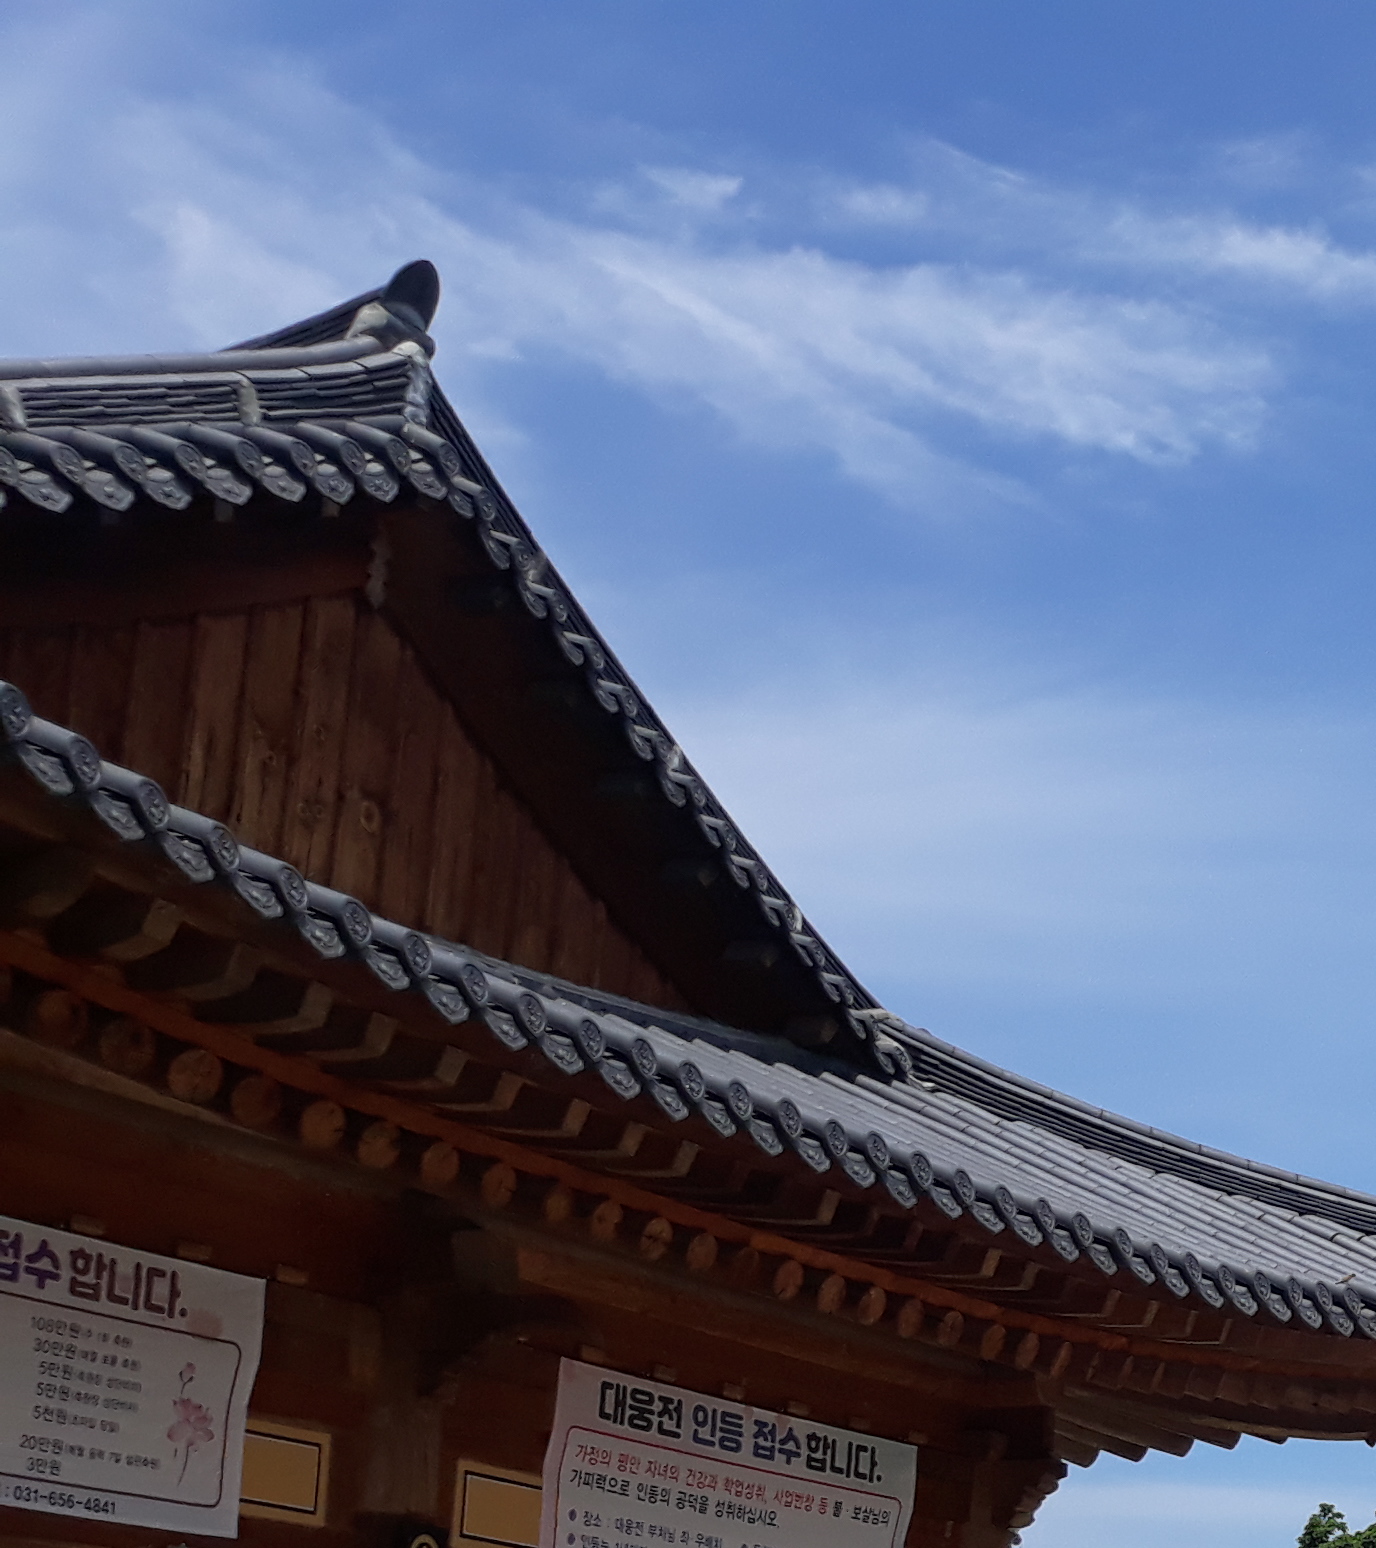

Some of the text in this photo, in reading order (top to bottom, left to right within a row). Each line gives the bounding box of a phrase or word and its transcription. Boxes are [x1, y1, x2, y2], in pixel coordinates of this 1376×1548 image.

[69, 1247, 188, 1318] 합니다.
[597, 1379, 685, 1439] 대웅전
[689, 1402, 746, 1454] 인등
[568, 1468, 781, 1529] 가피력으로 인등의 공덕을 성취하십시오.
[574, 1443, 612, 1470] 가정의
[643, 1458, 680, 1484] 자녀의
[685, 1467, 719, 1492] 건강과
[723, 1476, 768, 1503] 학업성취,
[817, 1496, 829, 1516] 등
[582, 1509, 603, 1529] 장소
